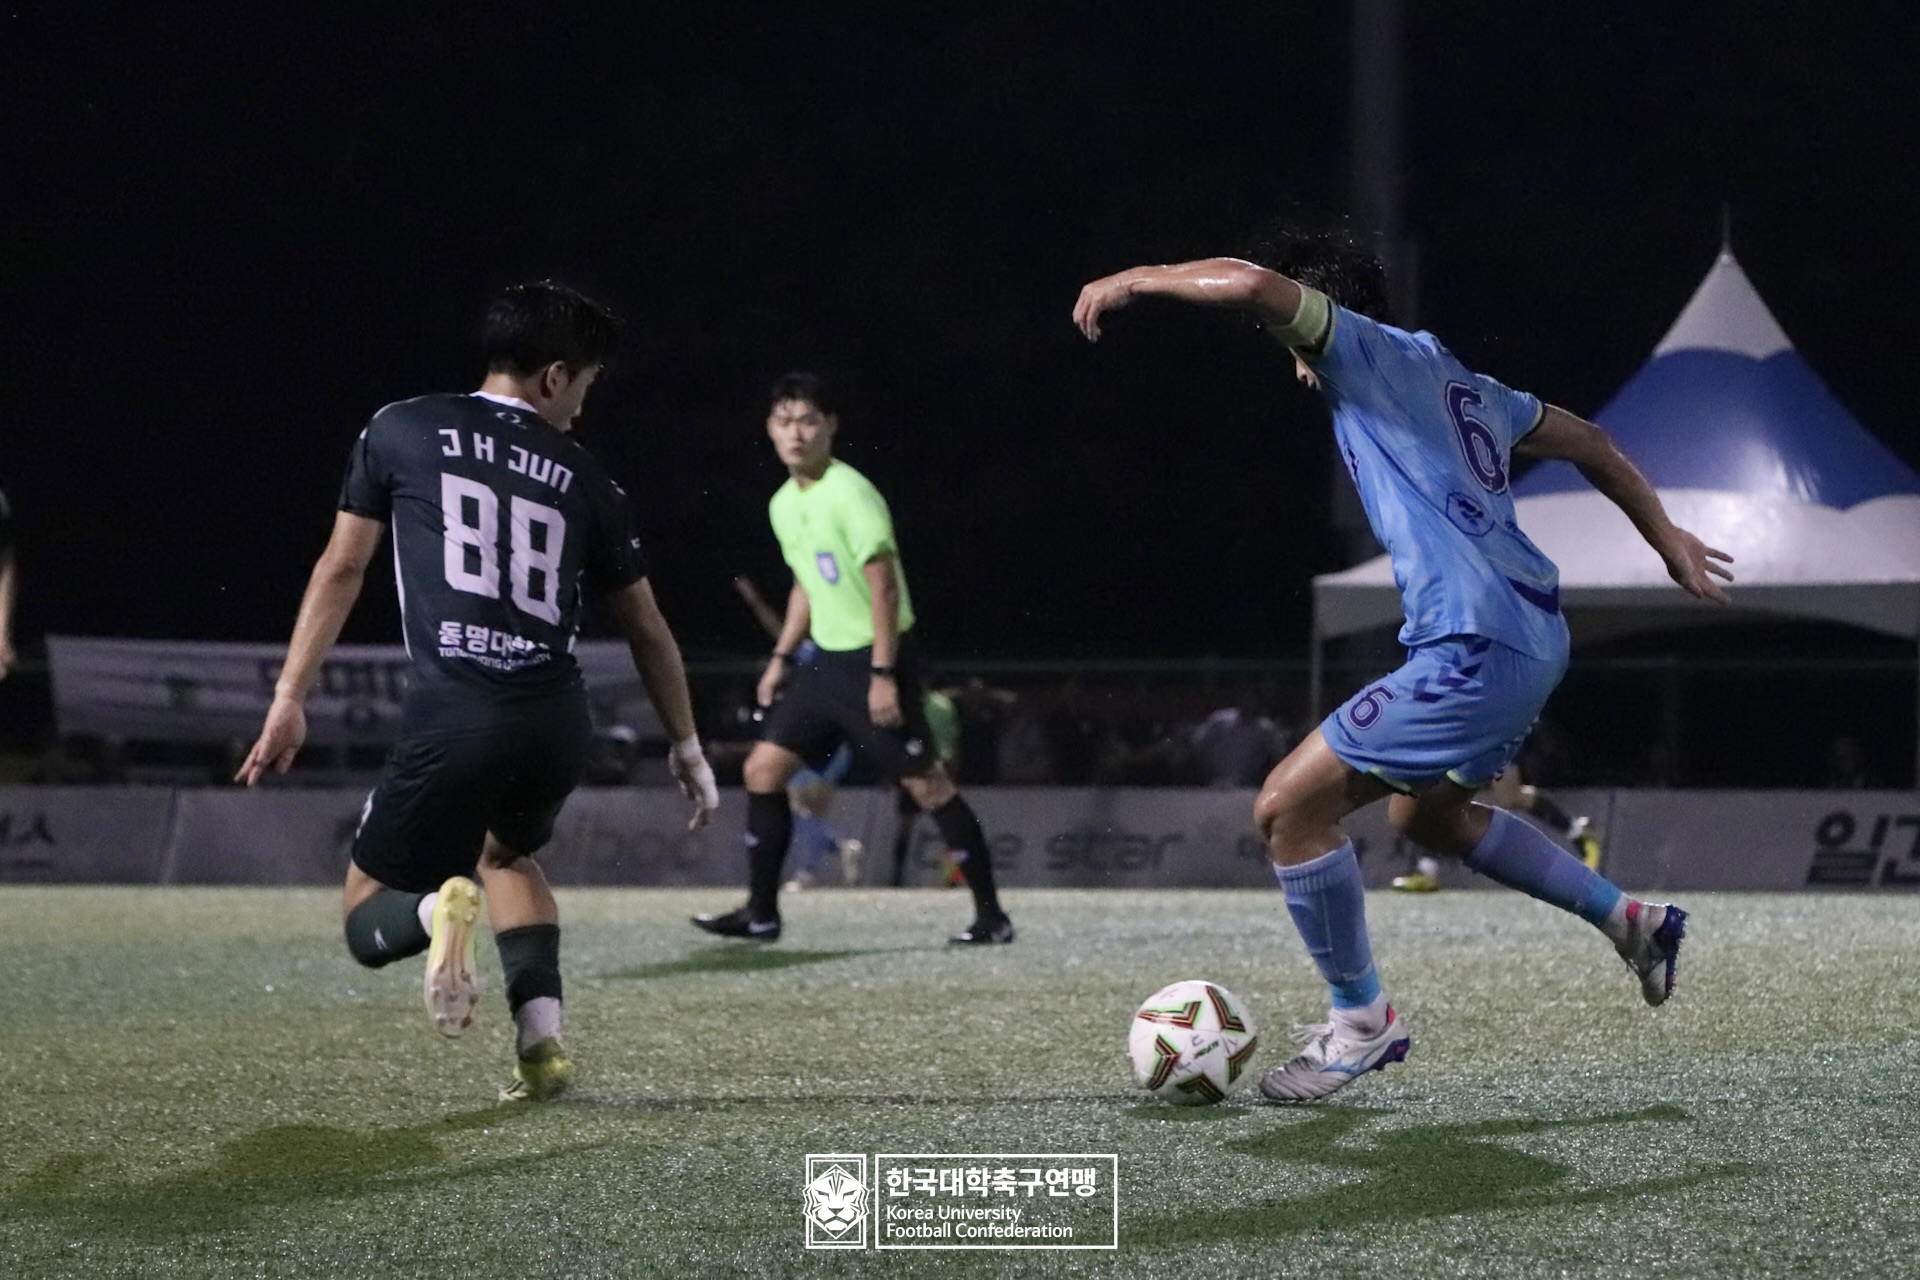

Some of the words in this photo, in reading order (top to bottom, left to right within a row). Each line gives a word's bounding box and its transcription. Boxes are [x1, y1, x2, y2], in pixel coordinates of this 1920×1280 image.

[438, 428, 462, 457] J
[473, 432, 494, 463] H
[507, 444, 574, 494] JUN
[1445, 379, 1509, 495] 6
[440, 471, 567, 627] 88
[1347, 684, 1397, 730] 6
[1042, 828, 1187, 872] star
